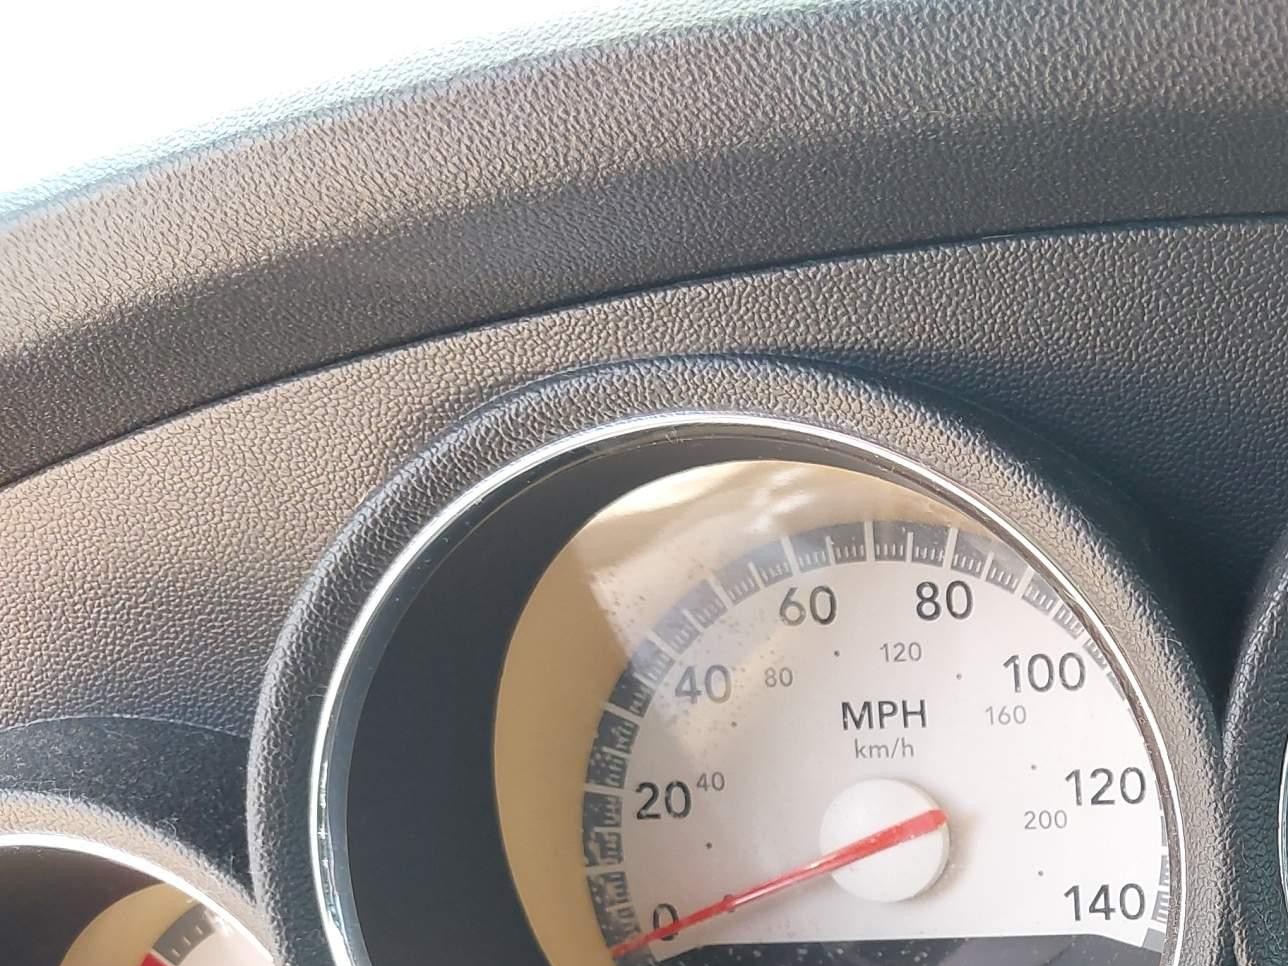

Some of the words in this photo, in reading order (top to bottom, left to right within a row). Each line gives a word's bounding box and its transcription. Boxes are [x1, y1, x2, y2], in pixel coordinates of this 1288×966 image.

[779, 584, 838, 627] 60
[915, 579, 974, 622] 80
[879, 641, 923, 663] 120
[674, 663, 732, 704] 40
[763, 667, 794, 688] 80
[1003, 652, 1086, 693] 100
[841, 700, 928, 730] MPH
[985, 705, 1027, 727] 160
[853, 739, 915, 759] km/h
[635, 781, 692, 820] 20
[697, 772, 726, 793] 40
[1065, 767, 1147, 806] 120
[1023, 810, 1068, 830] 200
[1064, 884, 1146, 922] 140
[652, 903, 680, 942] 0
